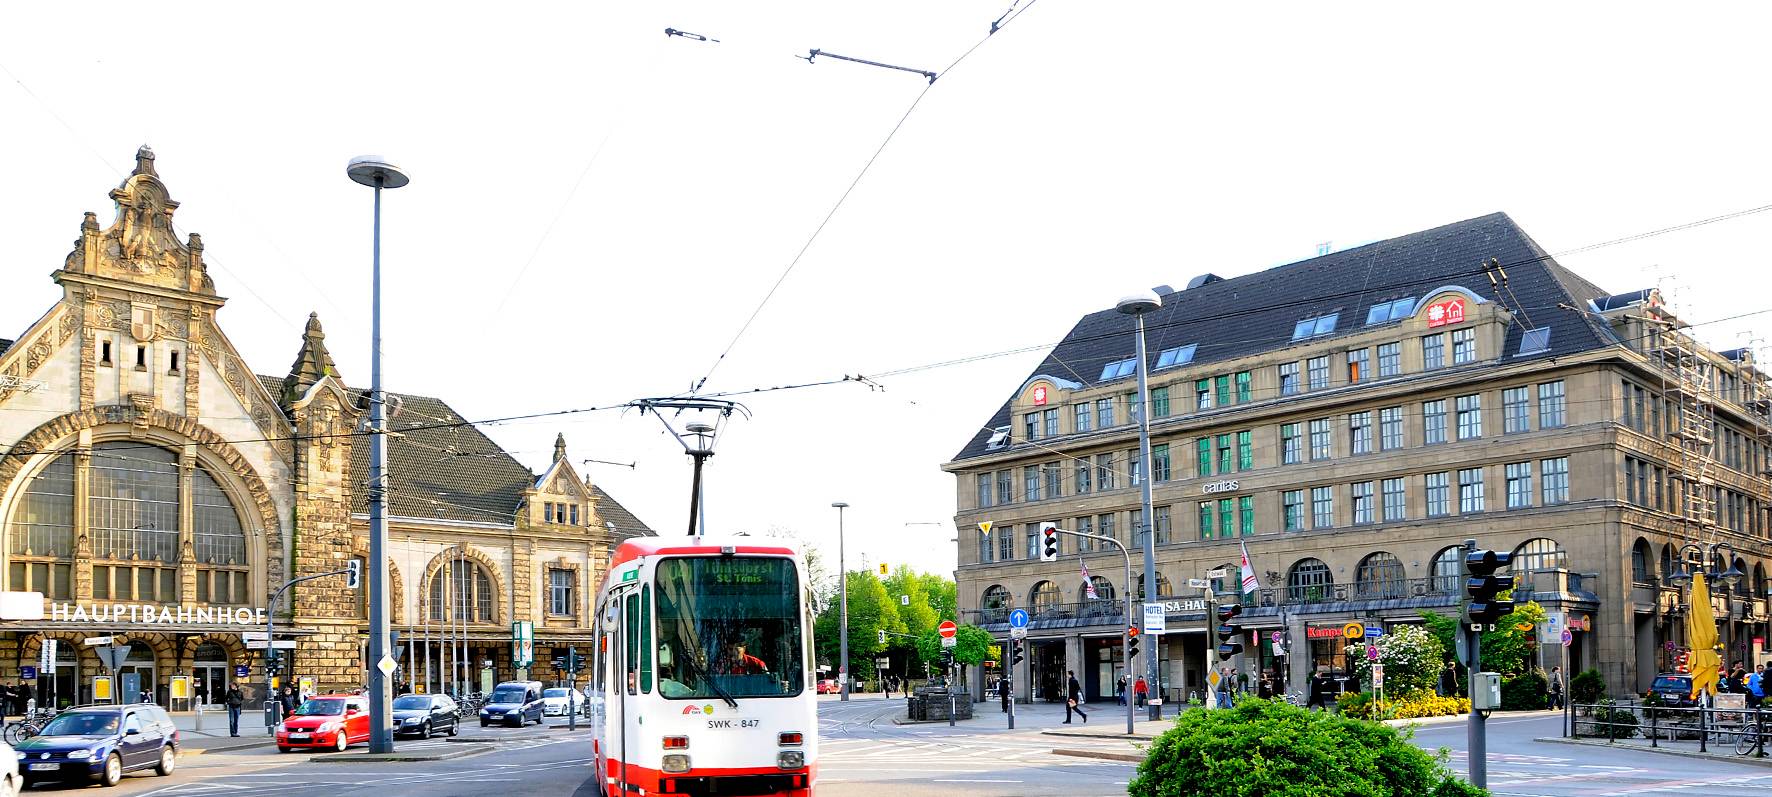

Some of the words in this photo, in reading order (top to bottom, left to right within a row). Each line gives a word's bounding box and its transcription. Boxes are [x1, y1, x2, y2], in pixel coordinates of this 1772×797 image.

[1202, 480, 1239, 493] caritas
[51, 602, 266, 625] HAUPTBAHNHOF
[1145, 605, 1164, 615] HOTEL
[1307, 627, 1343, 639] Kamps
[708, 720, 731, 729] SWK
[741, 719, 760, 728] 847
